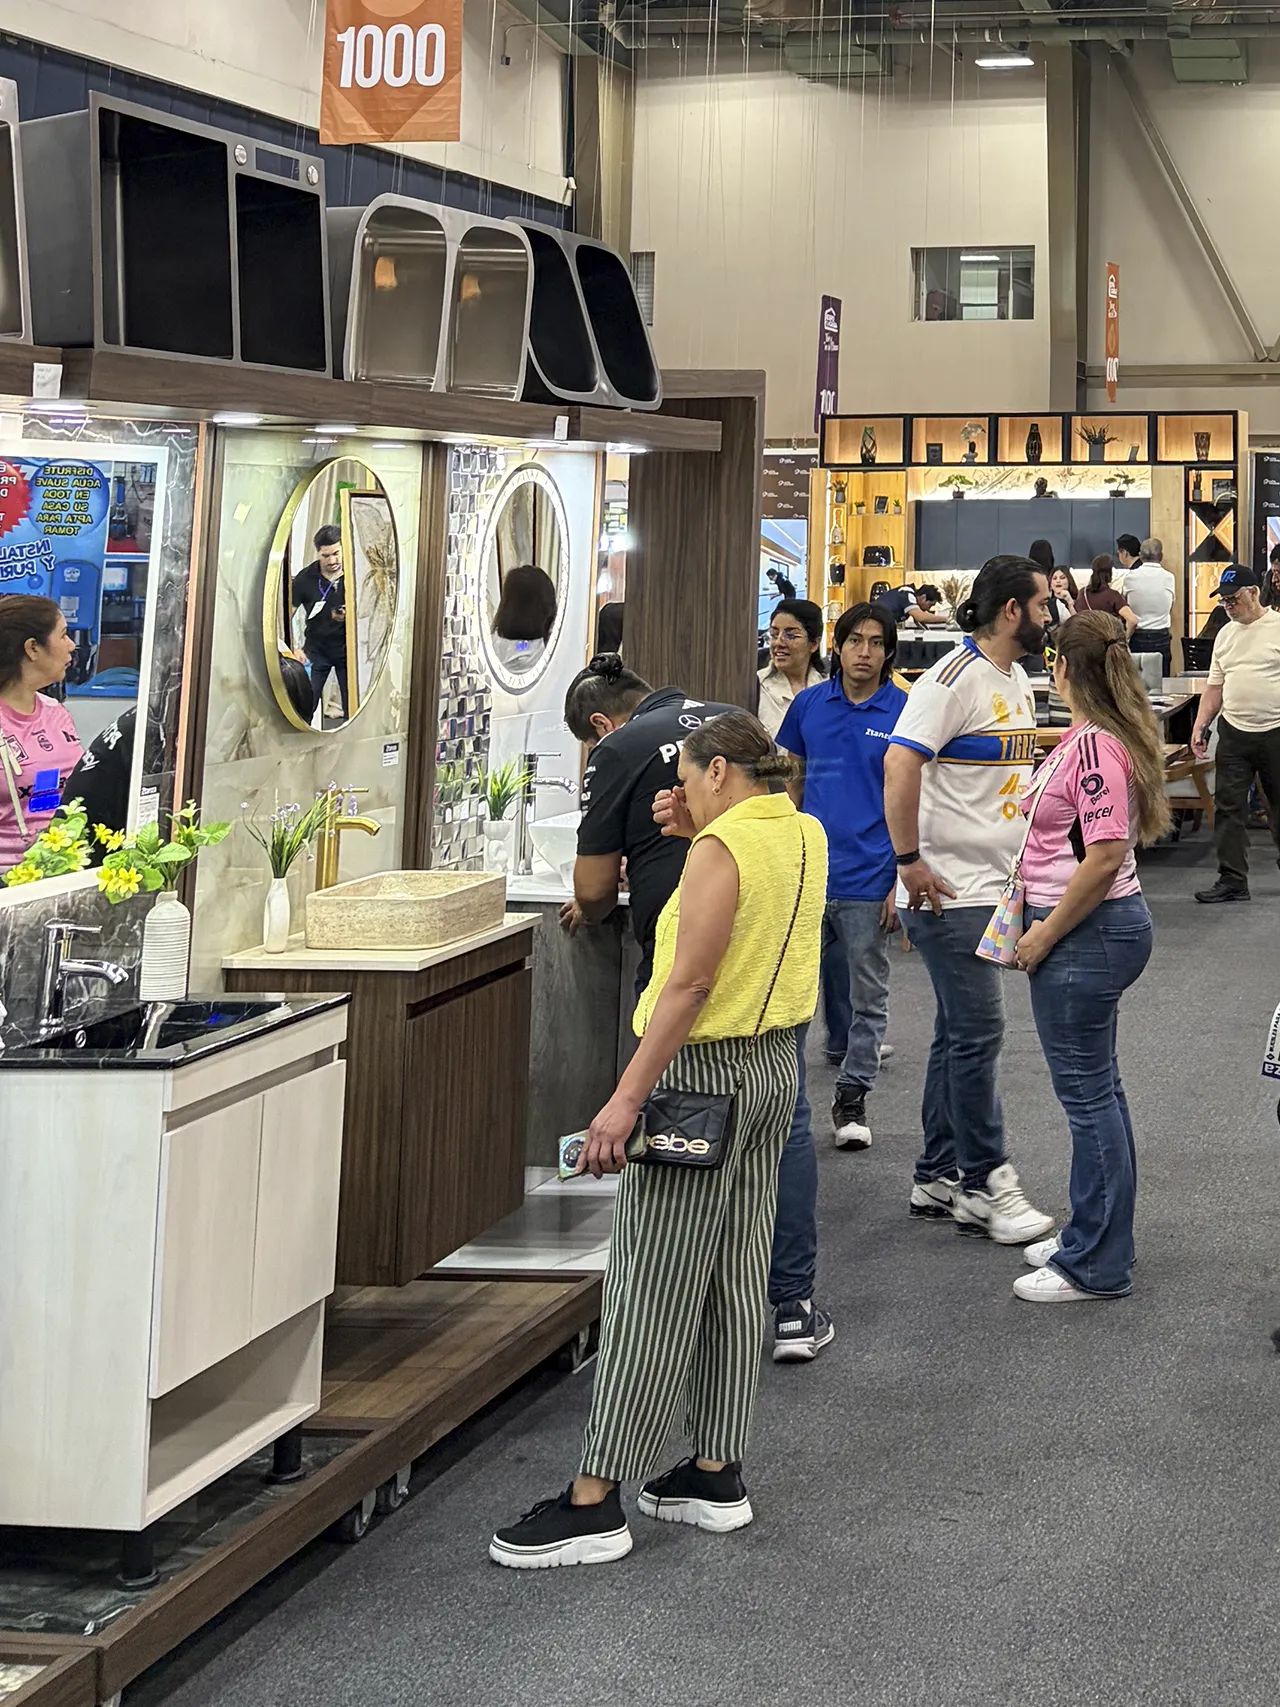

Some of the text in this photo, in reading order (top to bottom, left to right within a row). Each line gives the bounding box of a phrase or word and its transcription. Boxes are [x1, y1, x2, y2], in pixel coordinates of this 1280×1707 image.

[336, 23, 446, 88] 1000
[999, 735, 1035, 760] TIGRE
[647, 1133, 710, 1155] ebe
